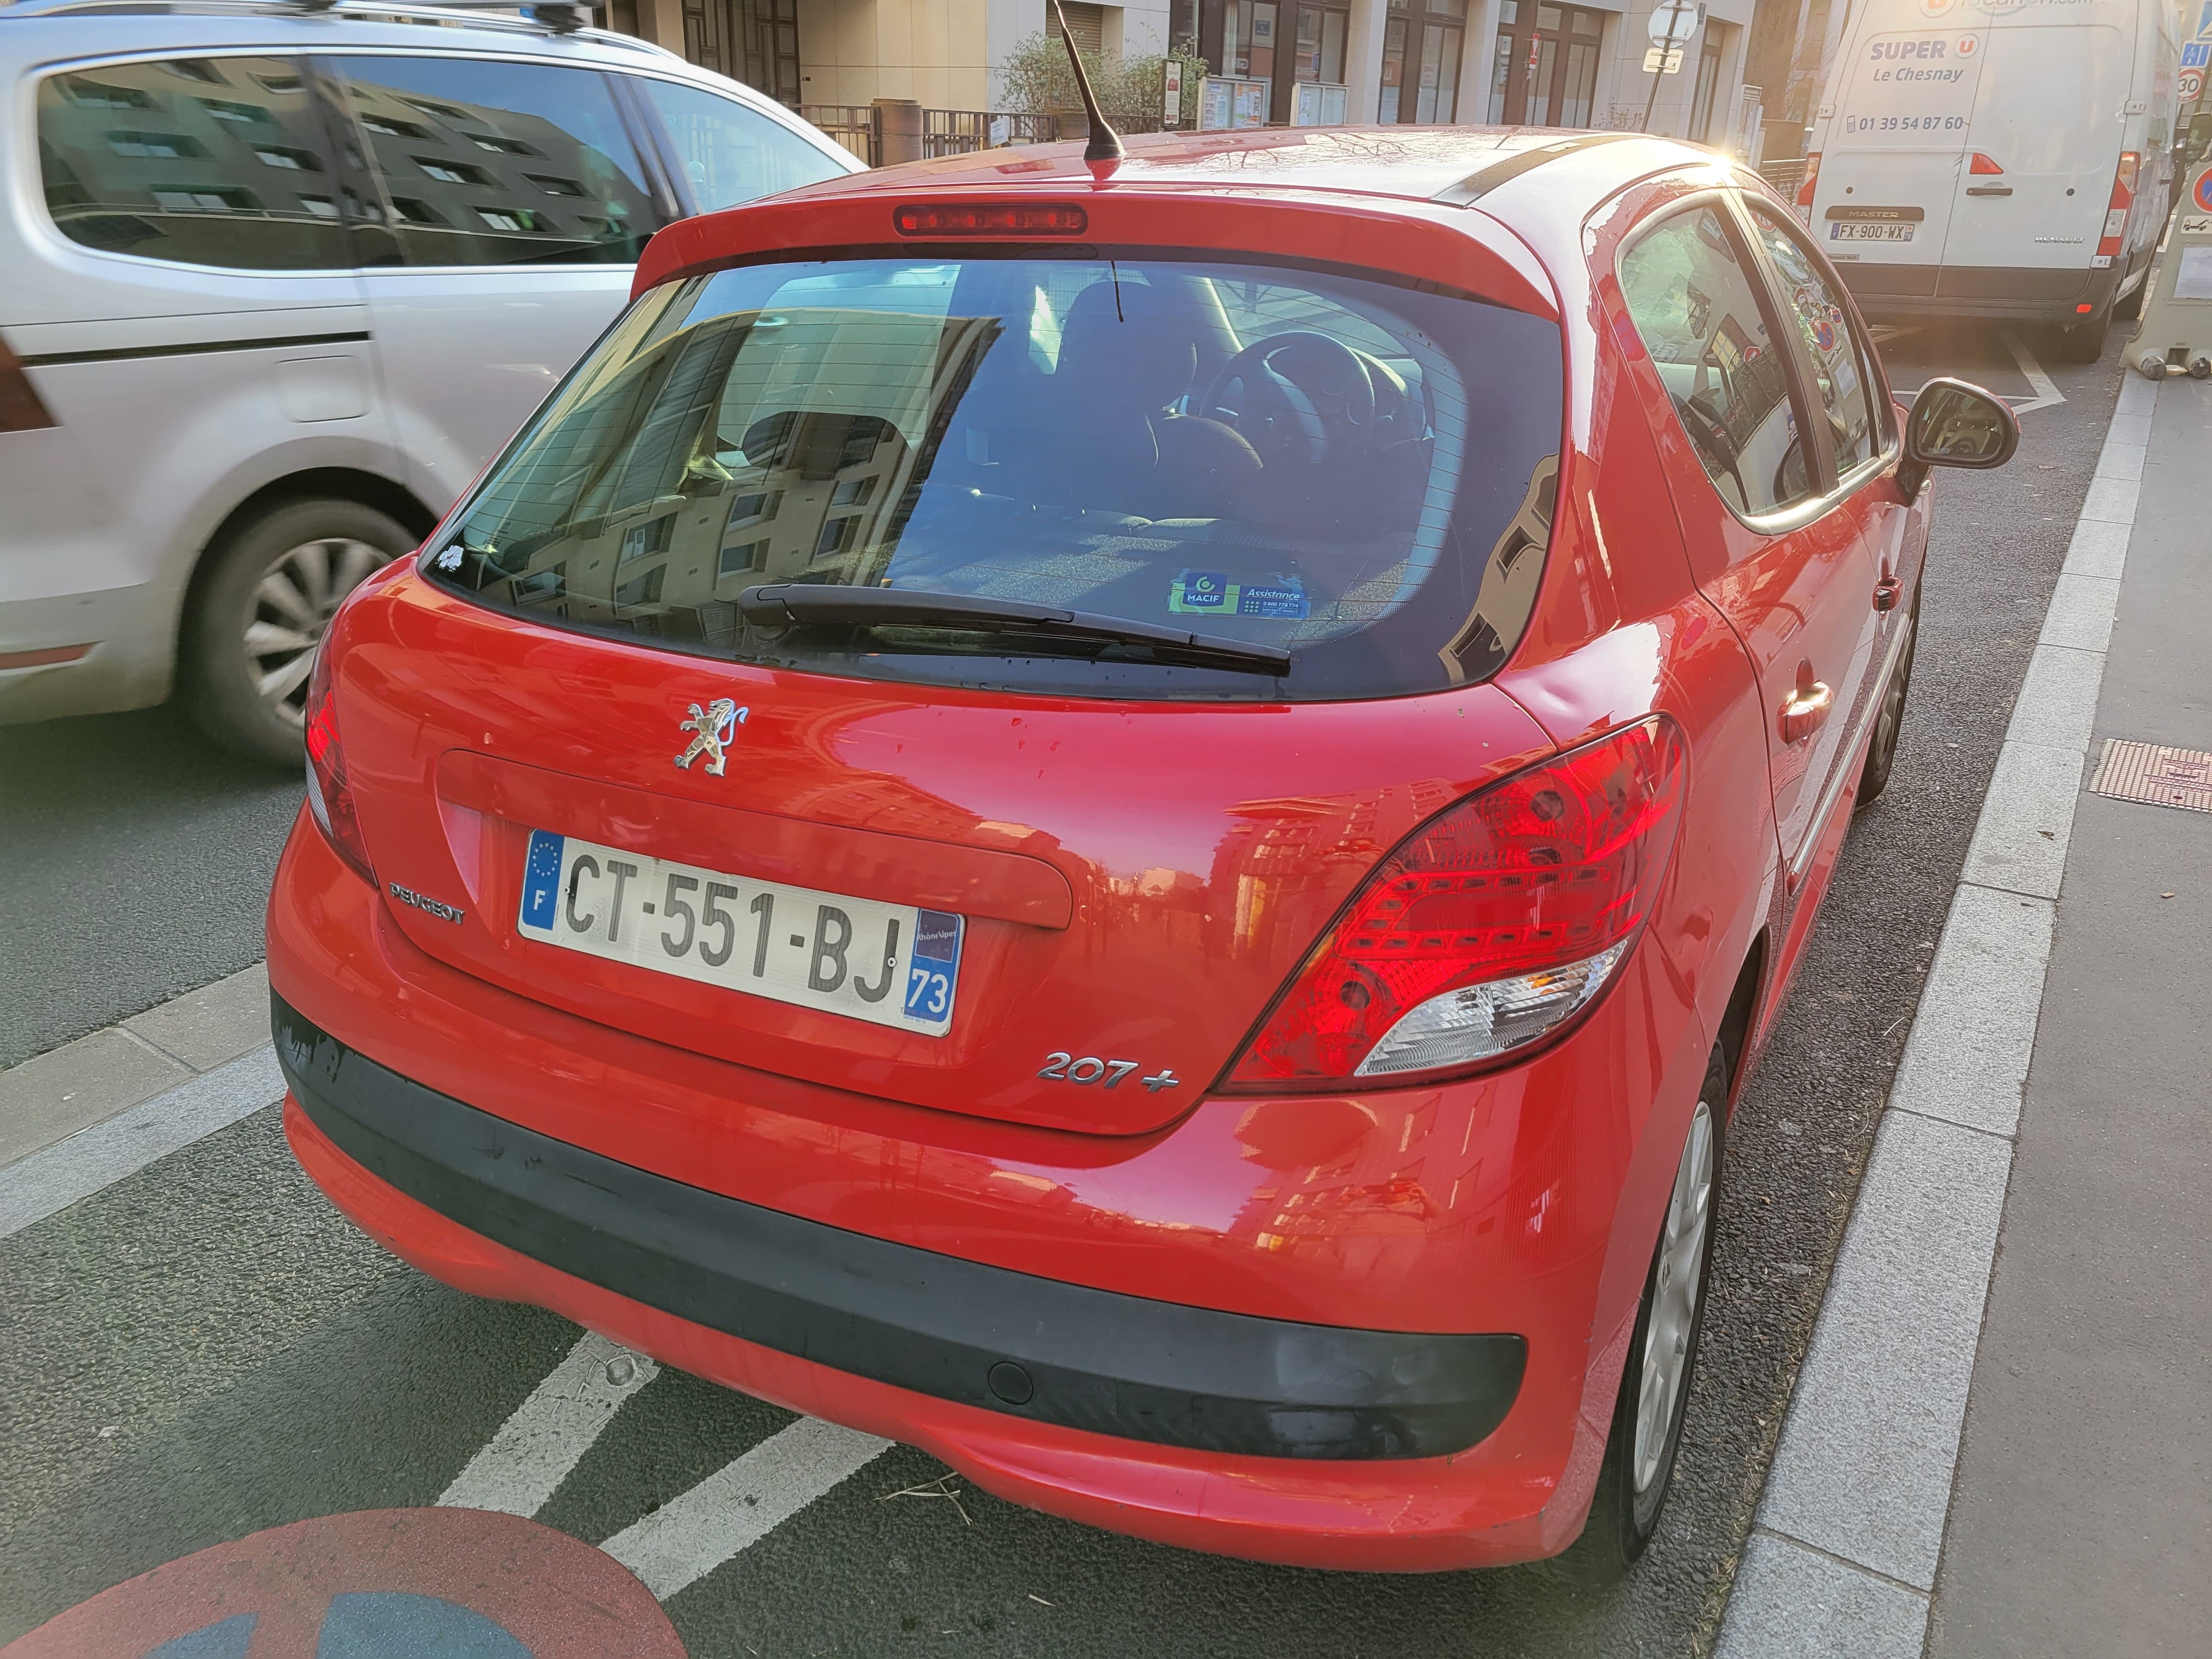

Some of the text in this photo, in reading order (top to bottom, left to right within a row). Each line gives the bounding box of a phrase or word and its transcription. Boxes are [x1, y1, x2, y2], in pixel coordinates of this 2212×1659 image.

[1870, 41, 1974, 60] SUPER U
[1873, 67, 1964, 83] Le Chesnay
[2179, 78, 2198, 92] 30
[1859, 117, 1963, 130] 01 39 54 87 60
[1839, 225, 1904, 239] FX-900-WX
[1187, 594, 1220, 603] MACIF
[1248, 588, 1300, 600] Assistance
[390, 882, 465, 924] PEUGEOT
[534, 855, 900, 1003] F CT-551-BJ
[908, 968, 948, 1013] 73
[1036, 1052, 1138, 1088] 207
